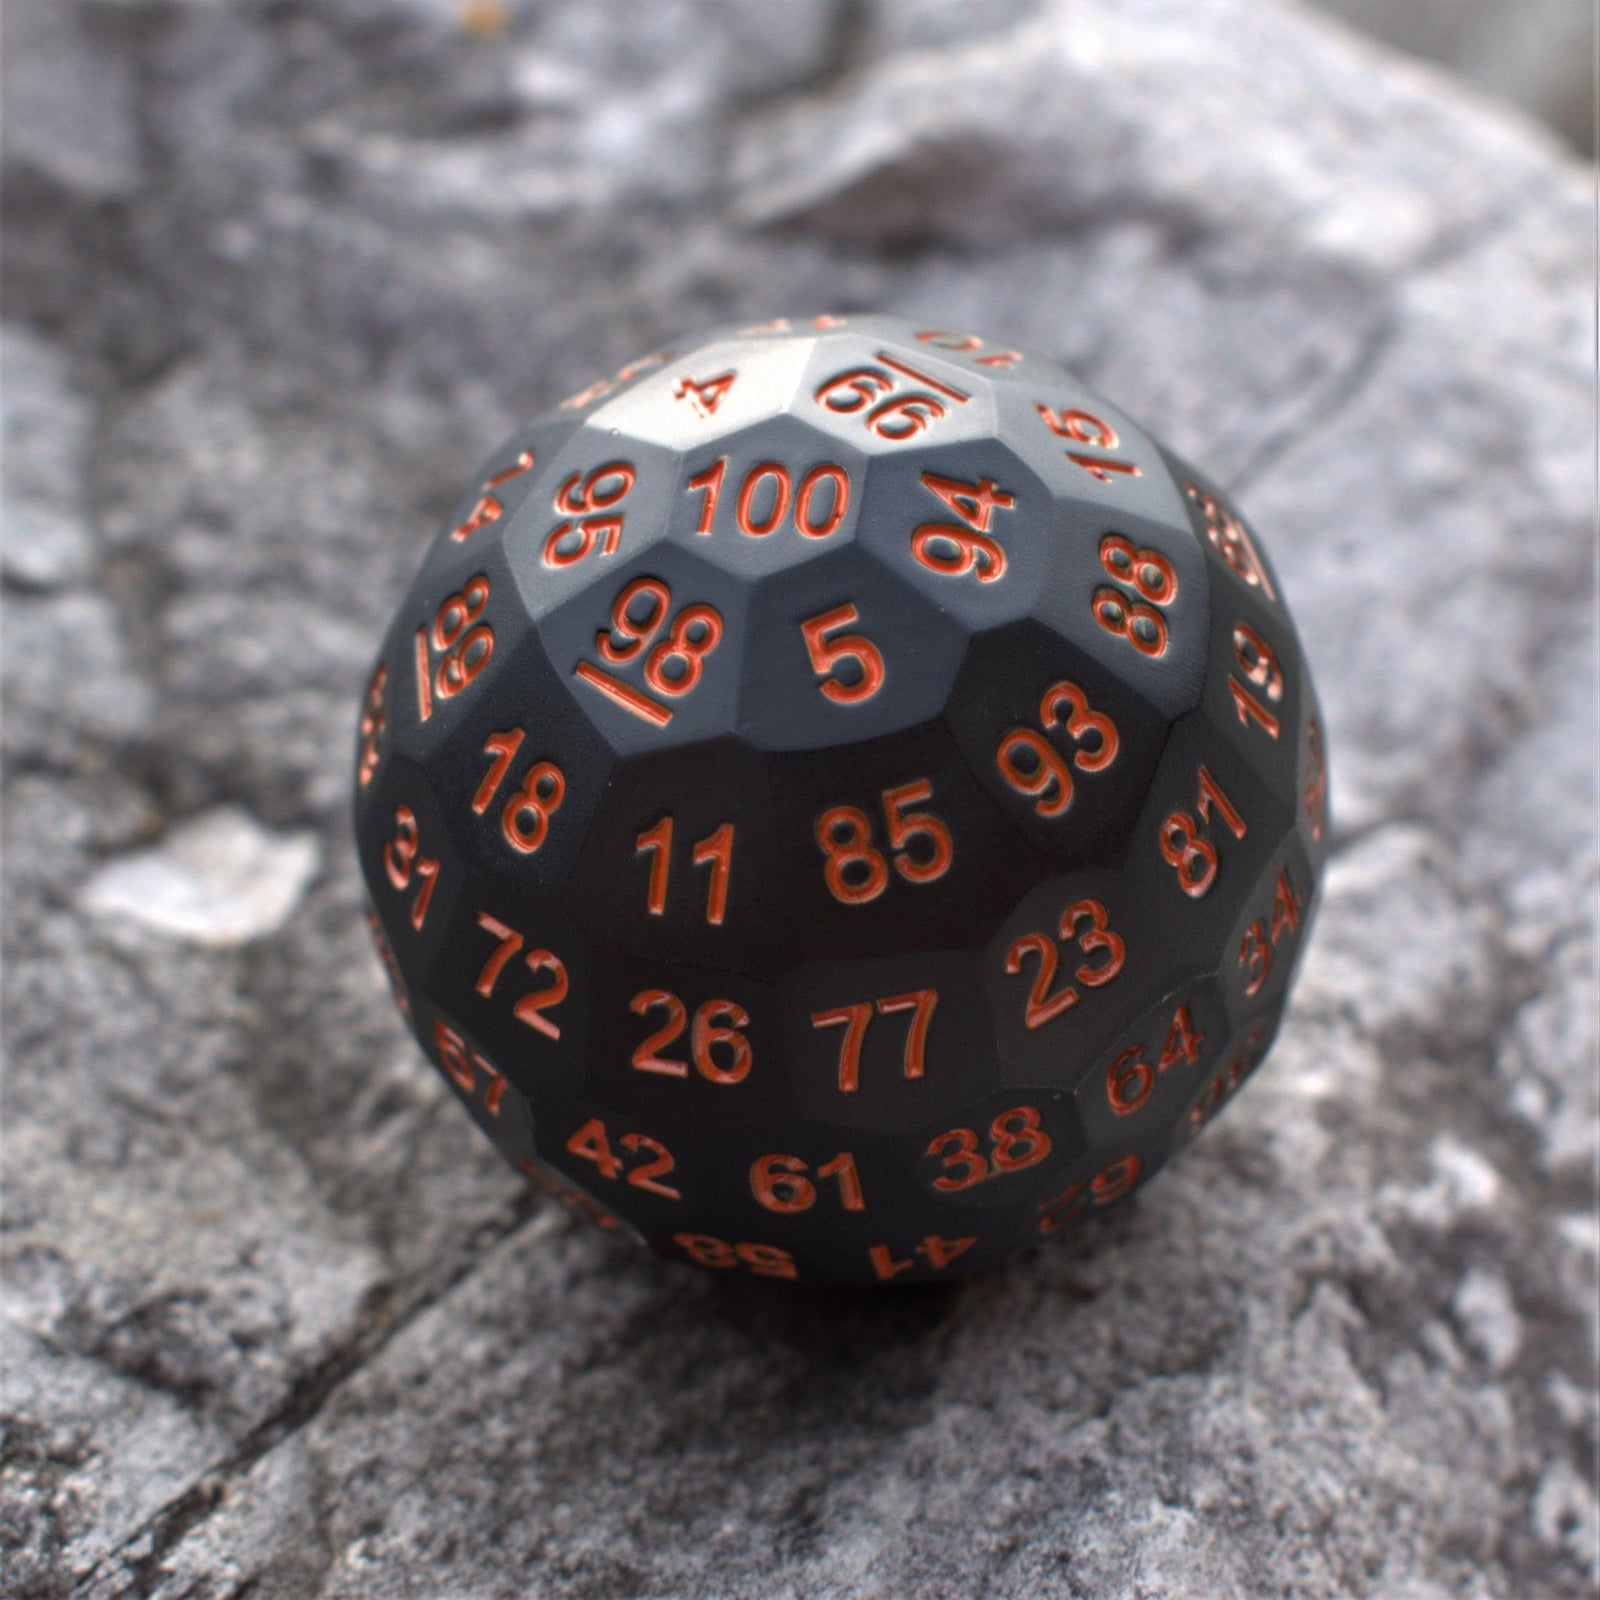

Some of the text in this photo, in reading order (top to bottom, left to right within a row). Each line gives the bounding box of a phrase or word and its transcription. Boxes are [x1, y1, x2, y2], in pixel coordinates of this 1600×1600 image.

[671, 371, 738, 420] 4
[813, 353, 972, 443] 99
[1036, 403, 1141, 484] 15
[541, 461, 637, 569] 95
[688, 457, 851, 539] 100
[910, 473, 1015, 584] 94
[415, 575, 496, 723] 89
[1091, 534, 1180, 660] 88
[575, 577, 725, 729] 98
[800, 602, 886, 706] 5
[1227, 622, 1284, 740] 19
[471, 727, 567, 855] 18
[996, 680, 1121, 818] 93
[384, 804, 441, 931] 31
[635, 815, 735, 926] 11
[815, 778, 954, 906] 85
[1158, 765, 1248, 897] 81
[475, 910, 570, 1041] 72
[1004, 897, 1127, 1030] 23
[1238, 870, 1303, 997] 34
[629, 988, 754, 1085] 26
[811, 988, 939, 1093] 77
[1105, 1004, 1205, 1117] 64
[565, 1116, 682, 1200] 42
[750, 1152, 866, 1214] 61
[926, 1105, 1053, 1193] 38
[674, 1233, 799, 1280] 58
[868, 1234, 978, 1281] 41
